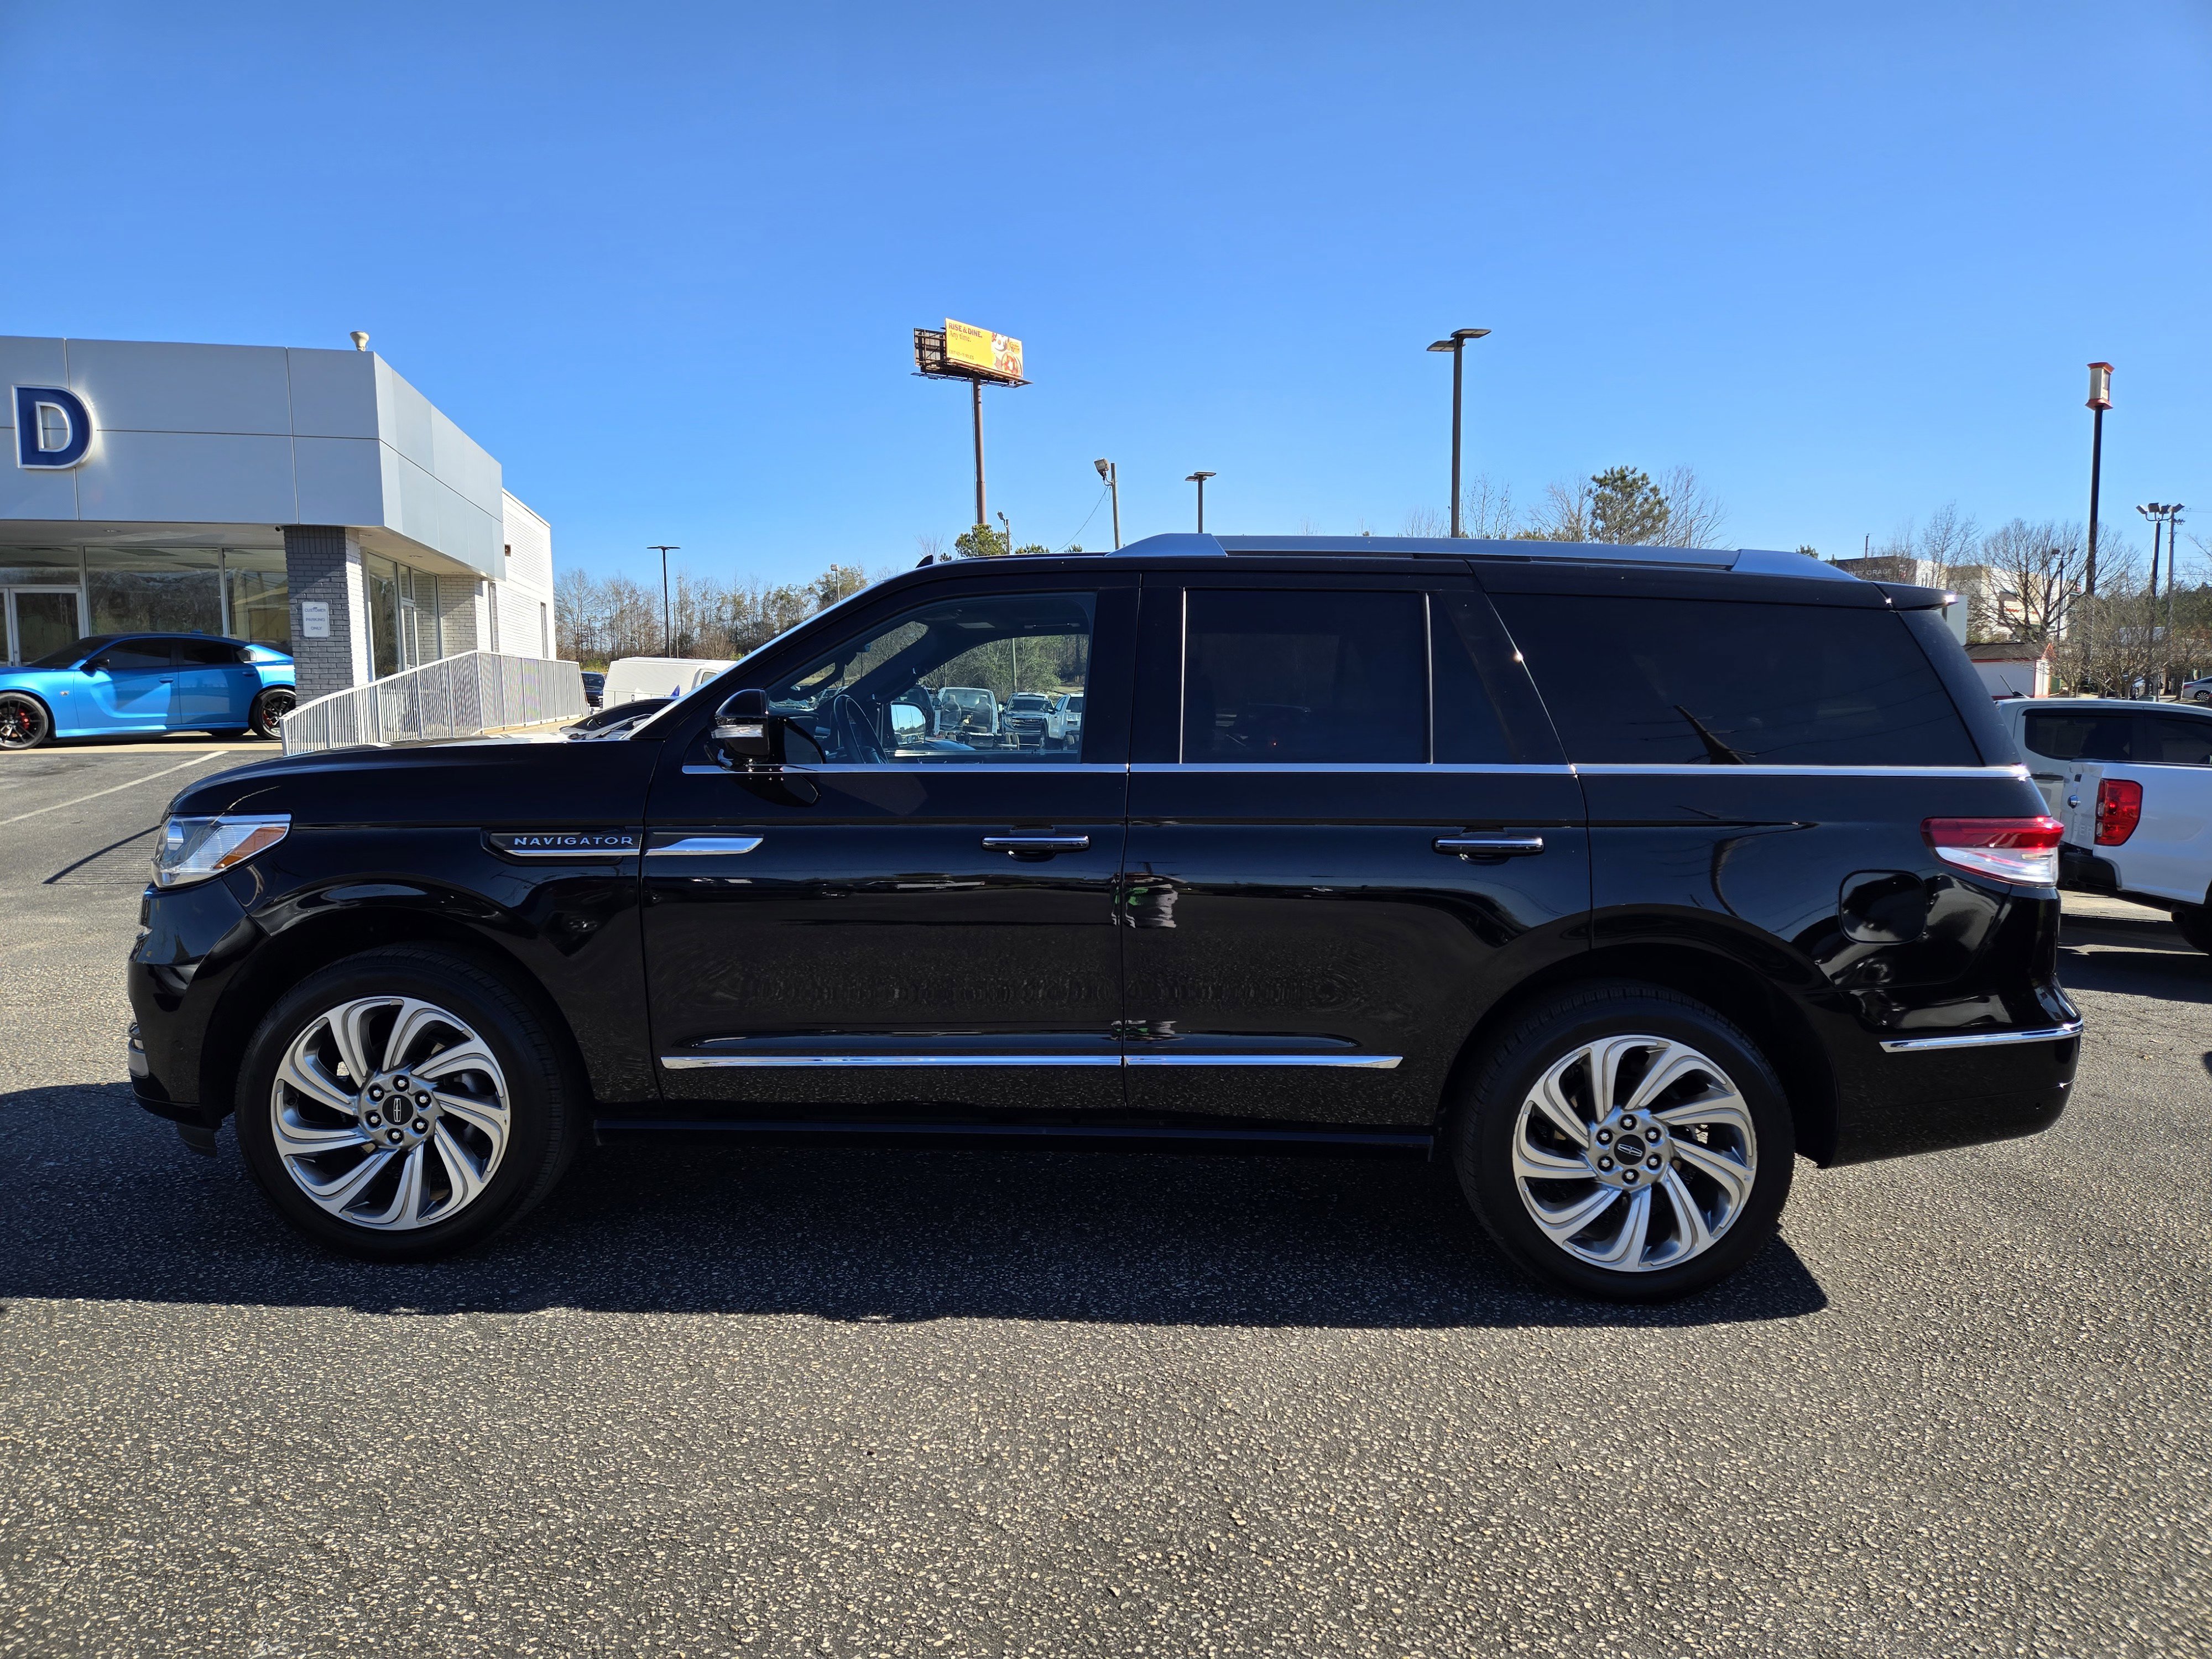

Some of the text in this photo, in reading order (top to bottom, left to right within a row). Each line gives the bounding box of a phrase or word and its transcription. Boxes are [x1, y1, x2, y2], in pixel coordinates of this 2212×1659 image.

[948, 322, 962, 332] RISE
[968, 328, 983, 338] DINE.
[950, 330, 972, 342] Any time.
[12, 384, 93, 469] D
[514, 837, 634, 846] NAVIGATOR
